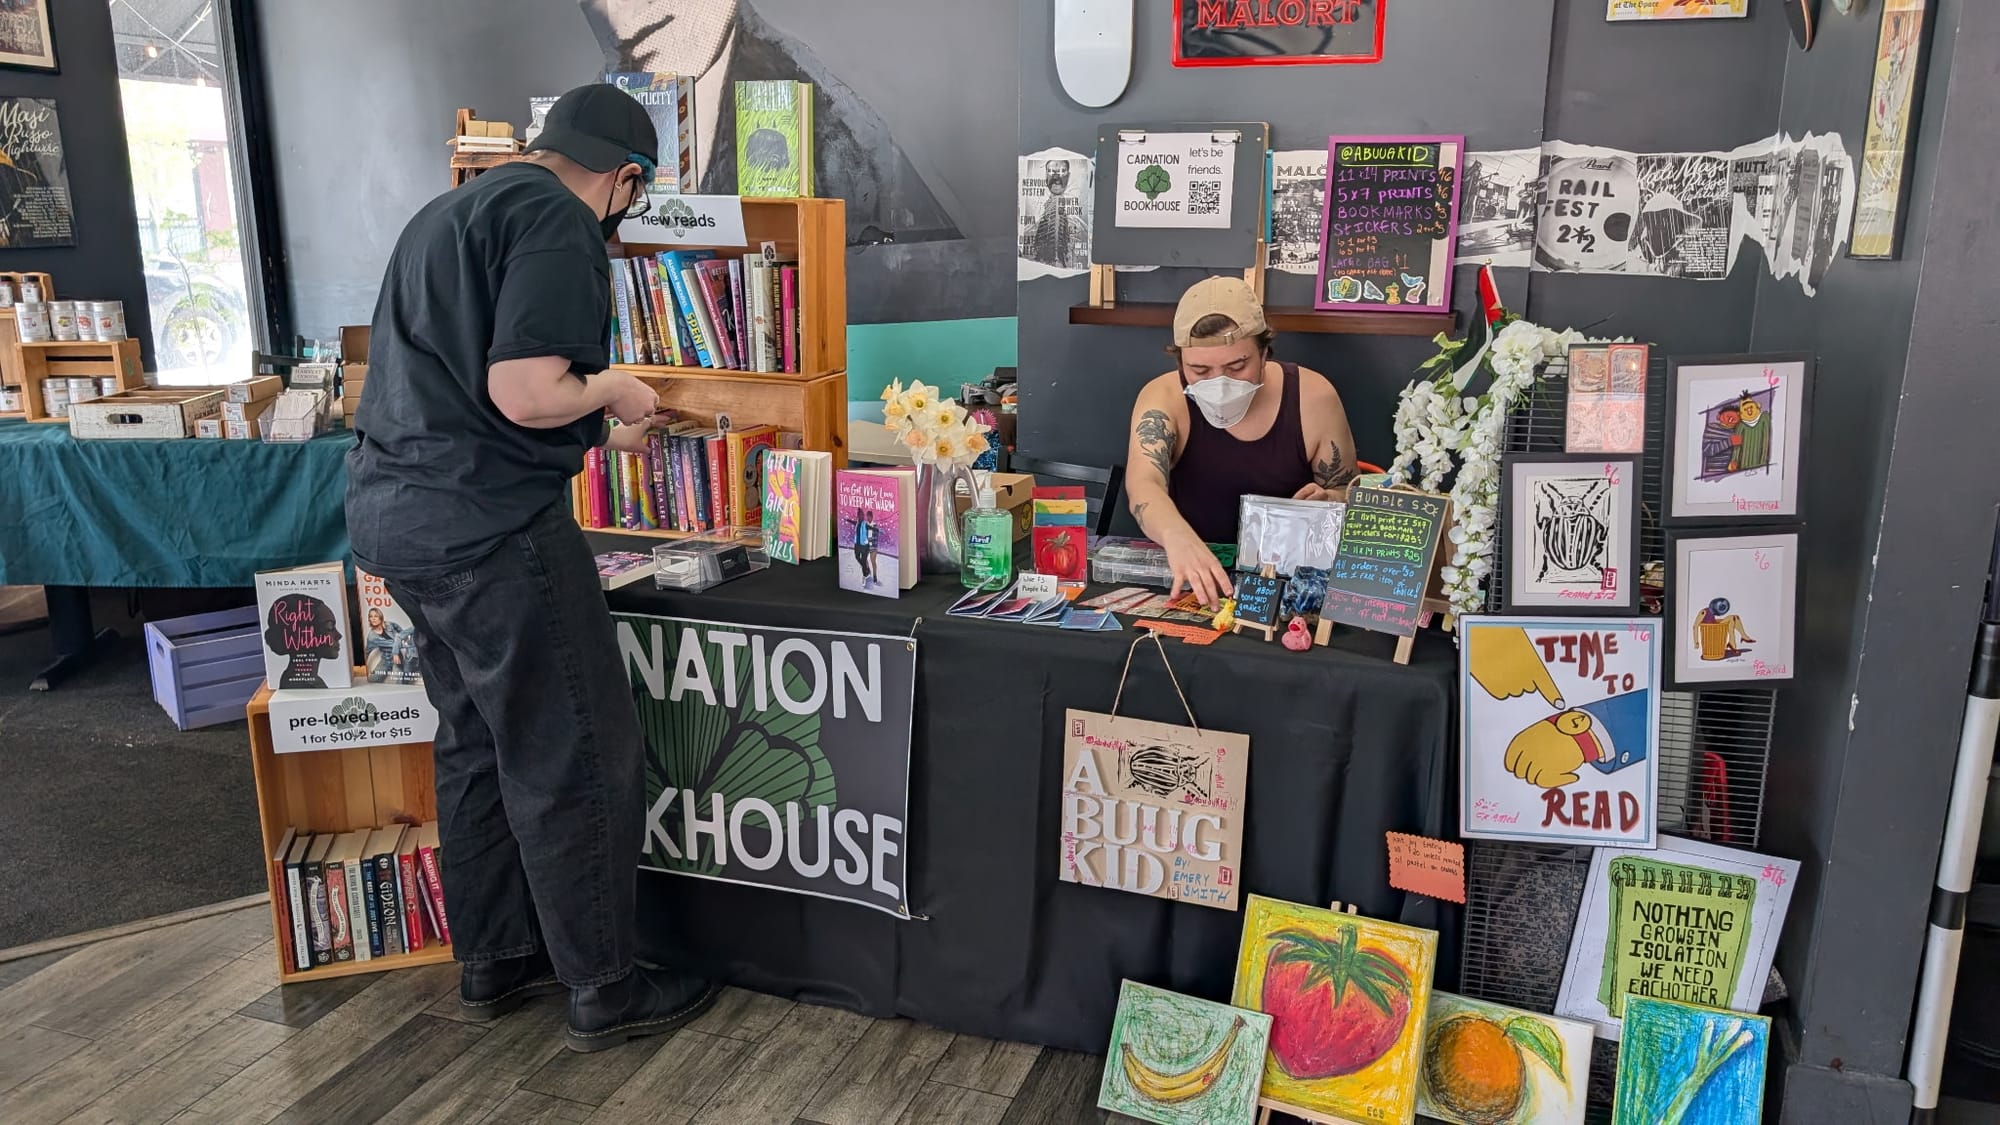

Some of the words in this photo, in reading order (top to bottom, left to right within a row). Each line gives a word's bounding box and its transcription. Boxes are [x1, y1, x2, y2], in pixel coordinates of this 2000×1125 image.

[1127, 154, 1180, 165] CARNATION
[1189, 148, 1209, 158] let's
[1210, 147, 1223, 158] be
[1187, 165, 1223, 175] friends.
[1383, 169, 1437, 182] PRINTS
[1022, 188, 1045, 196] SYSTEM
[1338, 187, 1348, 203] 5
[1378, 187, 1432, 204] PRINTS
[1559, 179, 1615, 198] RAIL
[1124, 200, 1180, 211] BOOKHOUSE
[1543, 199, 1599, 219] FEST
[641, 212, 671, 227] new
[674, 212, 716, 228] reads
[686, 312, 706, 352] SPENT
[767, 451, 798, 473] GIRLS
[766, 492, 795, 517] GIRLS
[840, 494, 848, 507] TO
[849, 495, 864, 508] KEEP
[865, 497, 875, 510] ME
[876, 499, 895, 513] WARM
[768, 535, 795, 562] GIRLS
[1351, 562, 1378, 571] orders
[366, 598, 392, 608] YOU
[273, 598, 315, 632] Right
[284, 625, 334, 651] Within
[1536, 631, 1619, 680] TIME
[1603, 673, 1635, 694] TO
[289, 709, 369, 731] pre-loved
[374, 706, 420, 722] reads
[310, 734, 327, 744] for
[359, 730, 367, 740] 2
[370, 730, 387, 739] for
[390, 726, 412, 738] $15
[1067, 748, 1109, 799] A
[1541, 788, 1640, 833] READ
[1064, 794, 1223, 862] BUUG
[423, 853, 437, 882] MAKING
[1062, 839, 1165, 895] KID
[1173, 870, 1210, 887] EMERY
[1183, 886, 1230, 904] SMITH
[1633, 900, 1734, 932] NOTHING
[1641, 963, 1664, 980] WE
[1672, 966, 1714, 987] NEED
